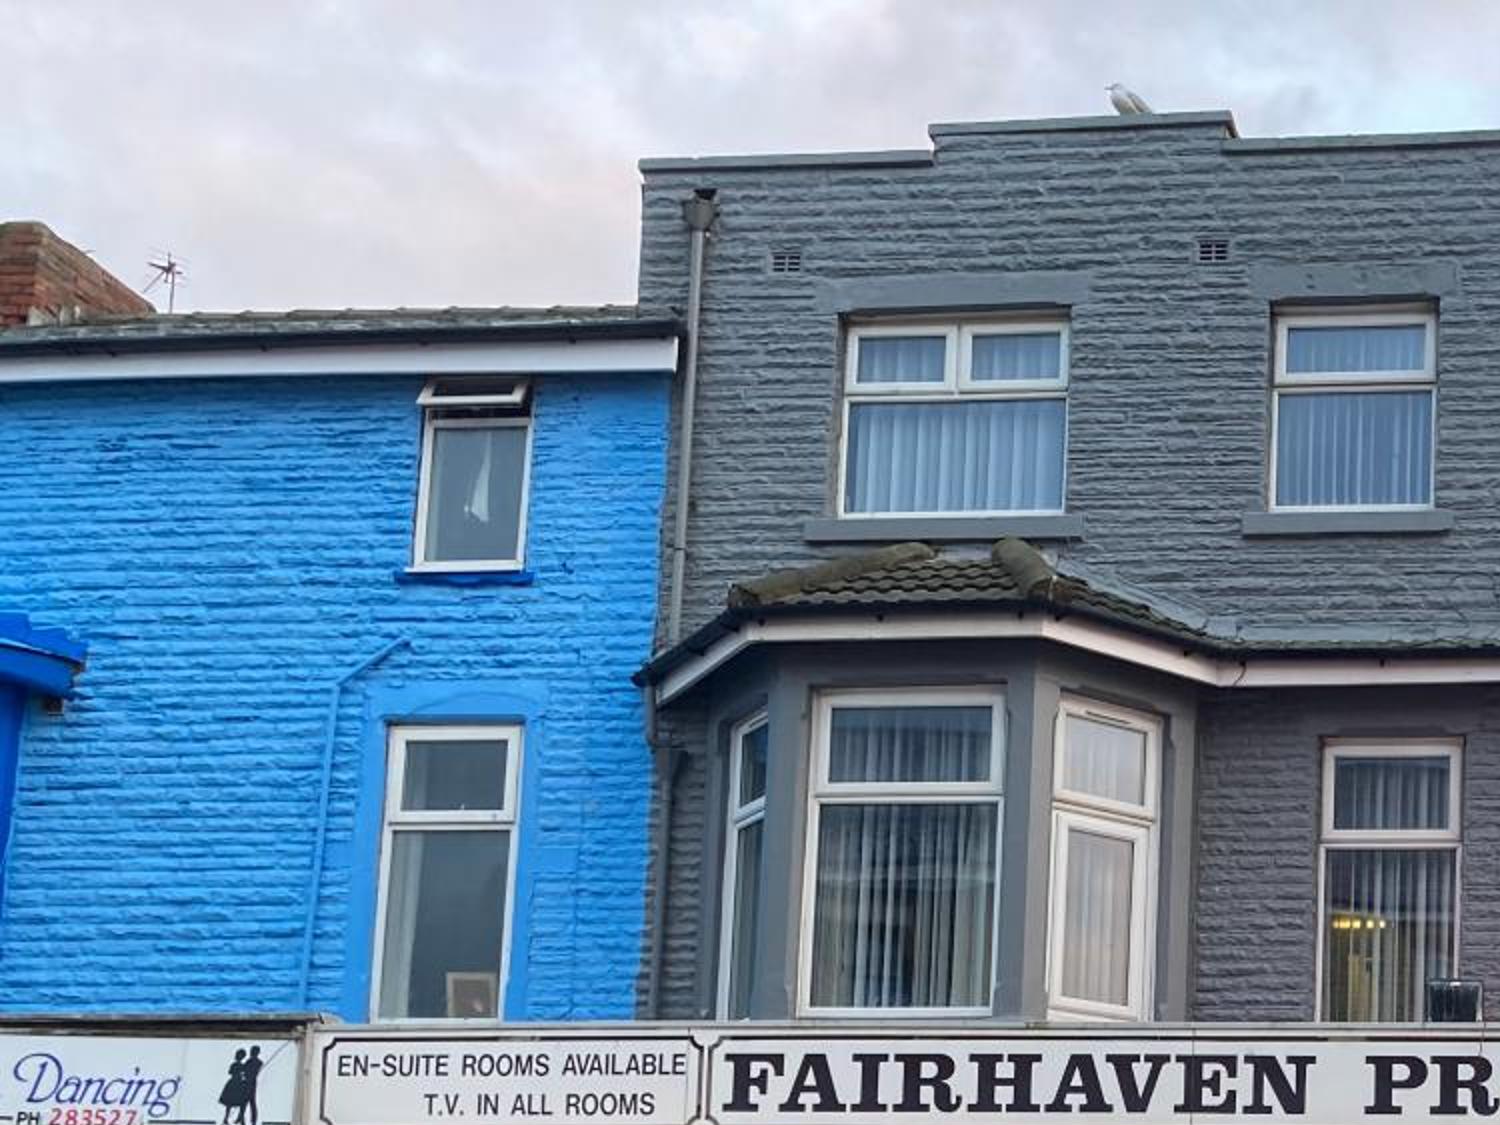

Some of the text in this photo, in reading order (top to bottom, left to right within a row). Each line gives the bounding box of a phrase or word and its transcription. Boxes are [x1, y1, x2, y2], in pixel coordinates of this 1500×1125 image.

[337, 1053, 688, 1078] EN-SUITE ROOMS AVAILABLE
[13, 1052, 182, 1119] Dancing
[721, 1052, 1316, 1116] FAIRHAVEN
[425, 1093, 655, 1117] T.V. IN ALL ROOMS
[16, 1111, 40, 1125] PH
